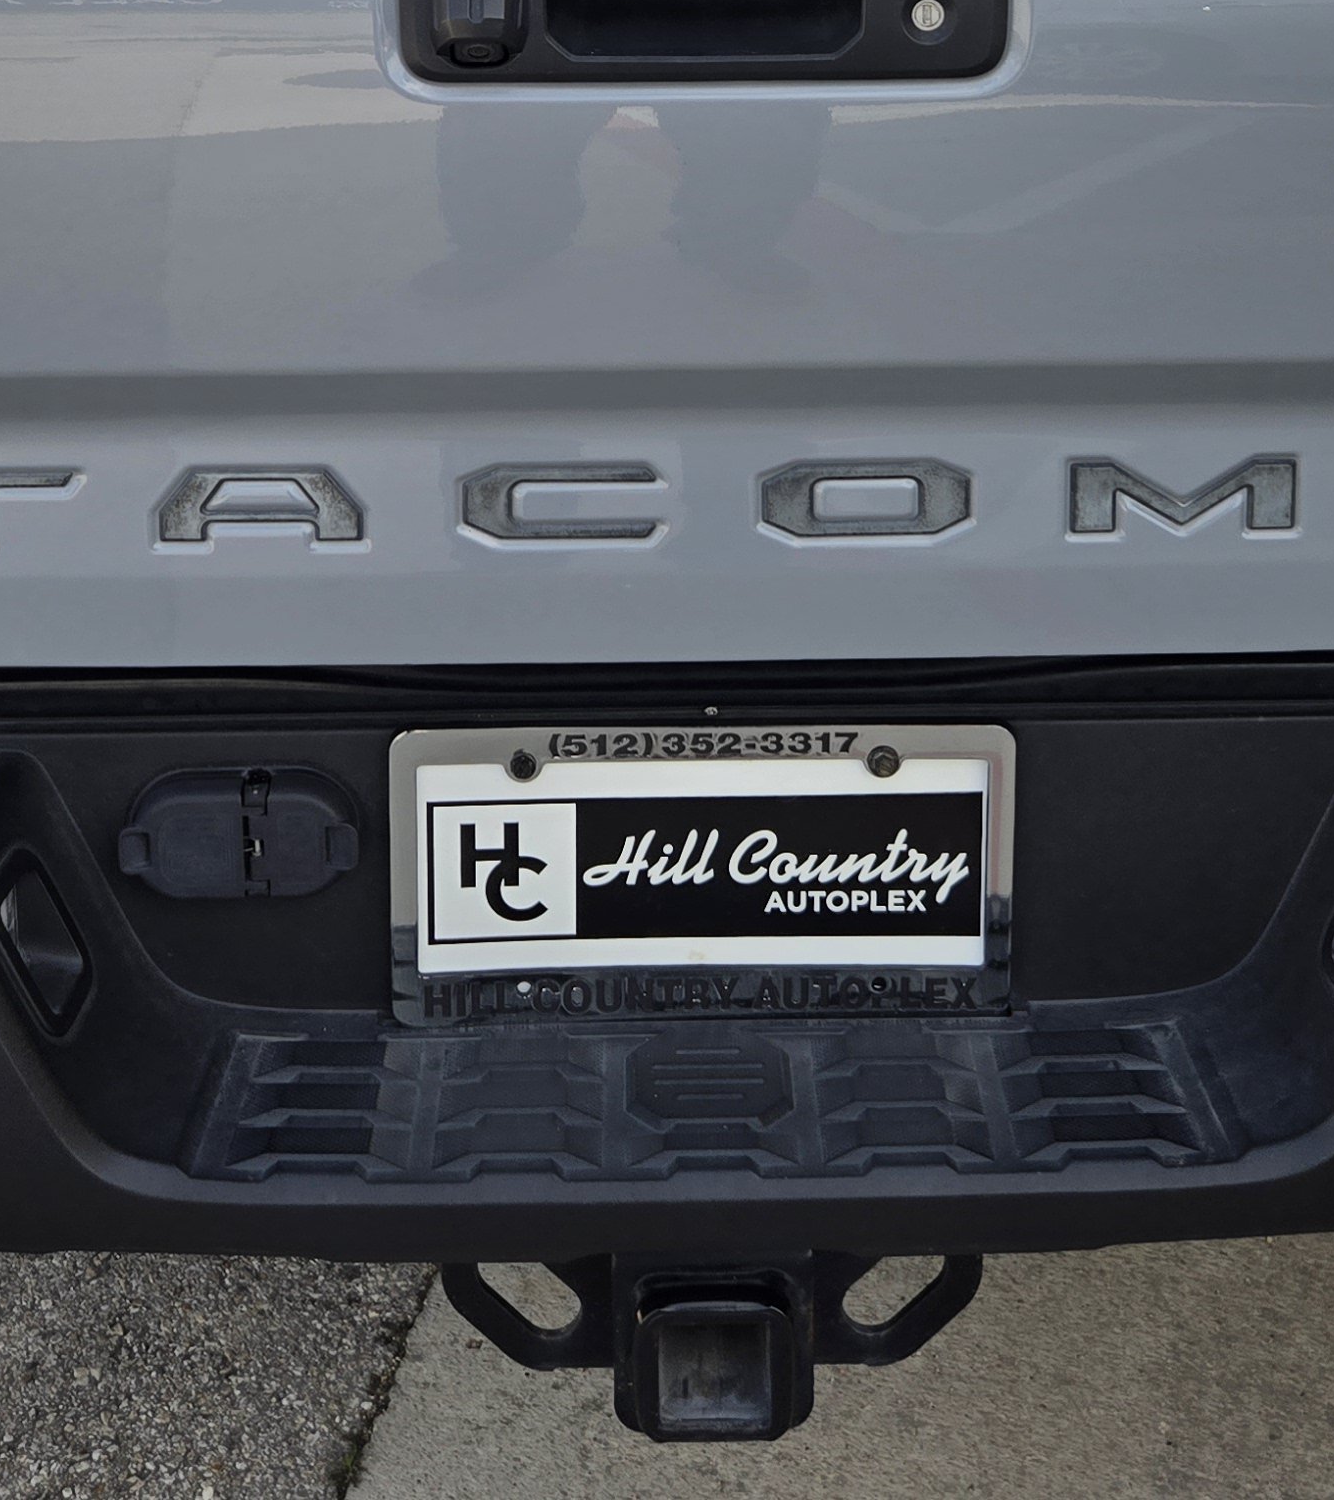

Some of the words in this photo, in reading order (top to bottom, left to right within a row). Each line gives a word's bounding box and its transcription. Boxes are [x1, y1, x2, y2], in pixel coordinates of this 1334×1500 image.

[582, 828, 720, 886] Hill
[728, 828, 970, 904] Country
[764, 889, 928, 913] AUTOPLEX
[423, 980, 518, 1018] HILL
[532, 977, 740, 1014] COUNTRY
[752, 975, 977, 1011] AUTOPLEX
